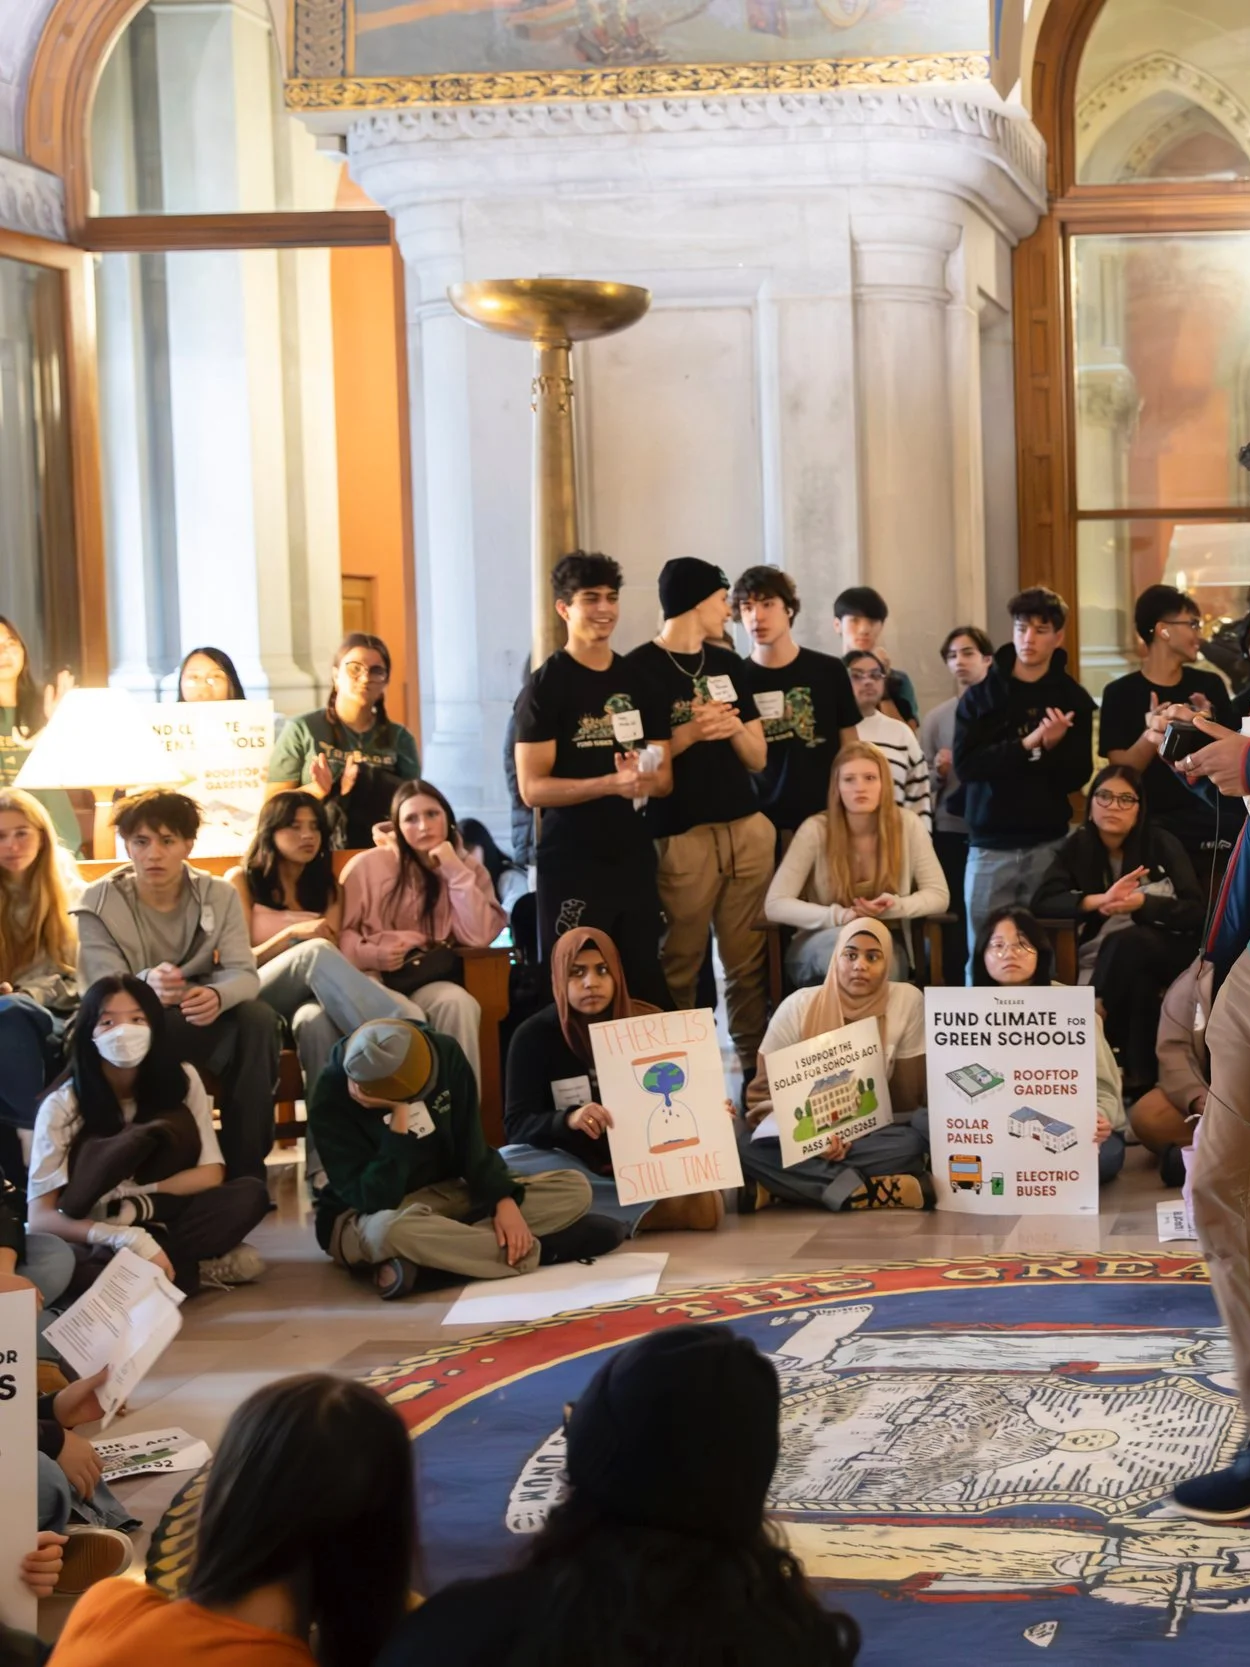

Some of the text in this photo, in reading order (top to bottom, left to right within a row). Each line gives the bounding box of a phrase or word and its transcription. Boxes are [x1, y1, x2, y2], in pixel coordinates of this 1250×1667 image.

[934, 1012, 1086, 1026] FUND CLIMATE FOR
[592, 1012, 708, 1055] THERE IS
[934, 1031, 1086, 1046] GREEN SCHOOLS
[801, 1047, 838, 1067] SUPPORT
[839, 1041, 853, 1053] THE
[774, 1073, 802, 1091] SOLAR
[804, 1066, 822, 1080] FOR
[823, 1051, 861, 1073] SCHOOLS
[1013, 1069, 1079, 1081] ROOFTOP
[1014, 1084, 1078, 1095] GARDENS
[946, 1118, 989, 1130] SOLAR
[946, 1133, 994, 1144] PANELS
[802, 1139, 824, 1155] PASS
[618, 1151, 726, 1201] STILL TIME
[1016, 1171, 1080, 1182] ELECTRIC
[1016, 1185, 1057, 1197] BUSES
[656, 1278, 876, 1318] THE
[519, 1454, 566, 1502] UNUM
